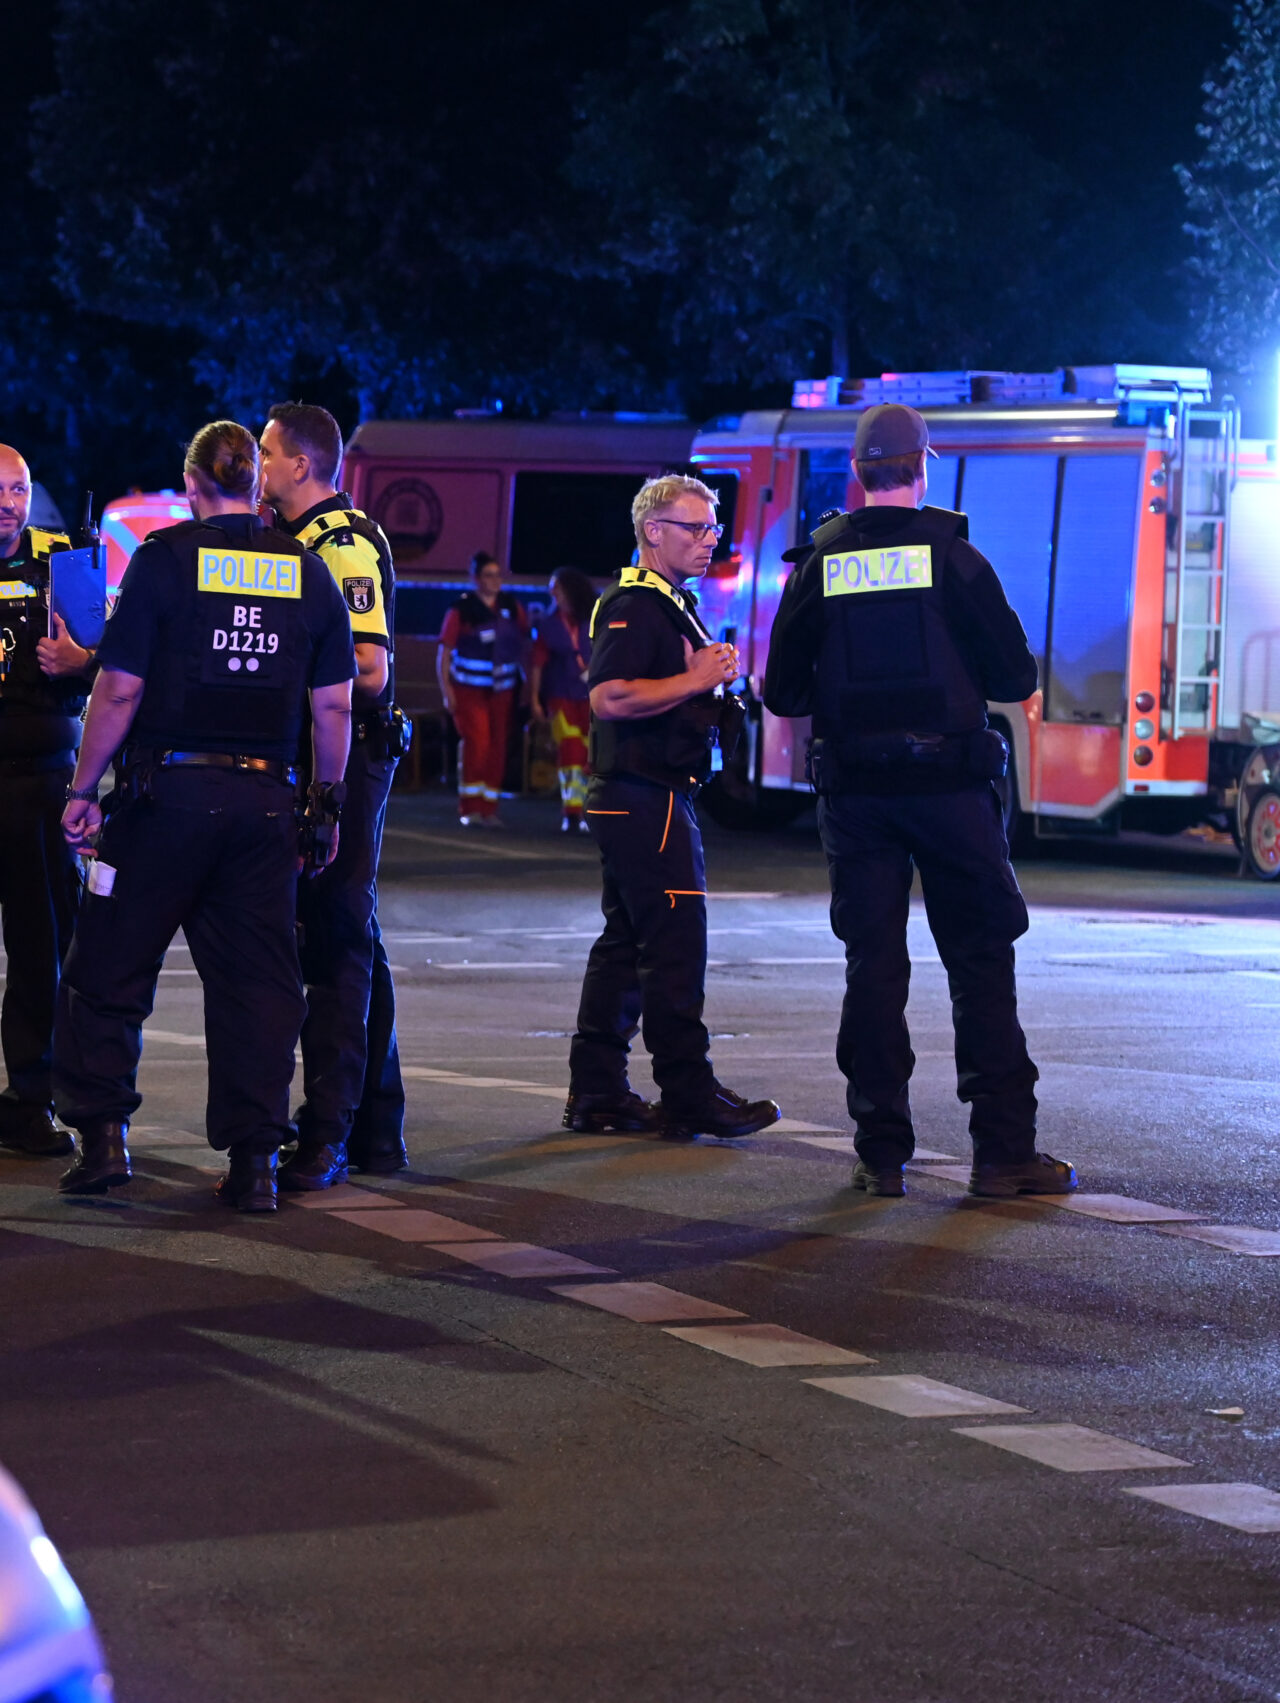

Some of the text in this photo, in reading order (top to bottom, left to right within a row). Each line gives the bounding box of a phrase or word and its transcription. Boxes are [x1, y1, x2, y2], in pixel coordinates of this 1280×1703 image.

[203, 555, 296, 592] POLIZEI
[827, 549, 928, 591] POLIZEI
[233, 605, 262, 628] BE
[212, 629, 279, 654] D1219
